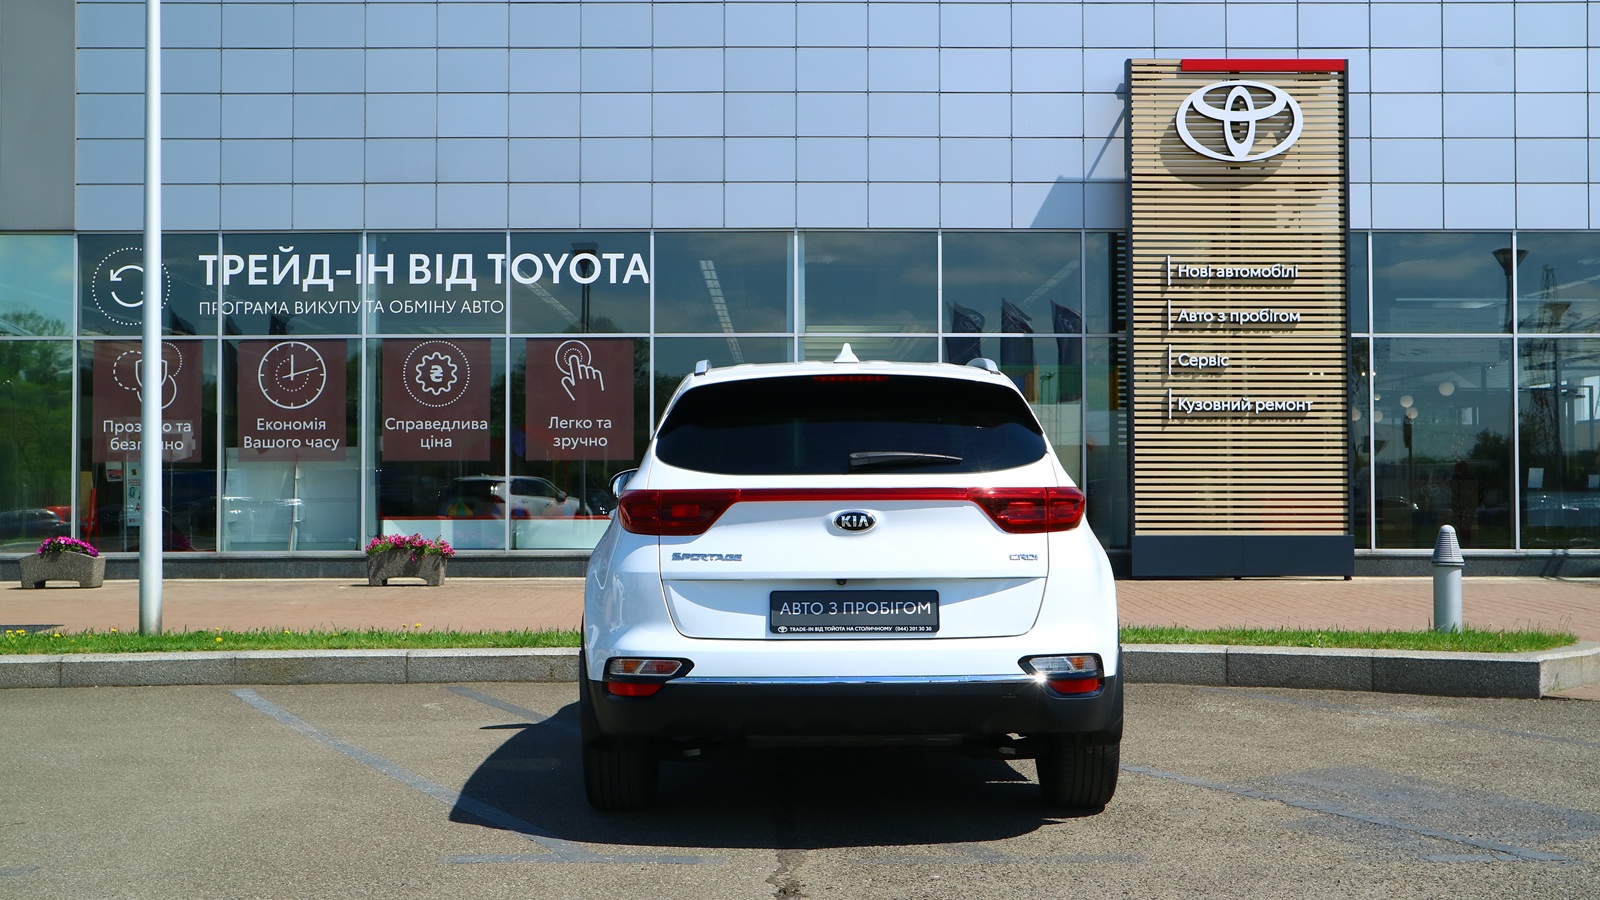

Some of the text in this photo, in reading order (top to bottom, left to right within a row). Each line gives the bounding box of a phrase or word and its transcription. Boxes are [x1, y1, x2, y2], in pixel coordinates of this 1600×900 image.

[198, 245, 650, 292] ТРЕЙД-ІН ВІД TOYOTA
[1178, 264, 1299, 278] Нові автомобілі
[199, 301, 289, 315] ПРОГРАМА
[294, 300, 361, 315] ВИКУПУ
[389, 300, 457, 314] ОБМІНУ
[461, 300, 504, 314] АВТО
[1178, 308, 1300, 325] Авто з пробігом
[1178, 353, 1230, 369] Сервіс
[1178, 397, 1314, 414] Кузовний ремонт
[103, 420, 192, 435] Прозо та
[256, 418, 326, 430] Економія
[385, 418, 488, 433] Справедлива
[548, 416, 612, 429] Легко та
[110, 437, 184, 450] безно
[243, 436, 340, 450] Вашого часу
[420, 436, 453, 449] ціна
[553, 437, 608, 450] зручно
[840, 515, 869, 528] KIA
[671, 552, 743, 562] SPORTAGE
[779, 602, 824, 615] АВТО
[843, 601, 931, 615] ПРОБІГОМ
